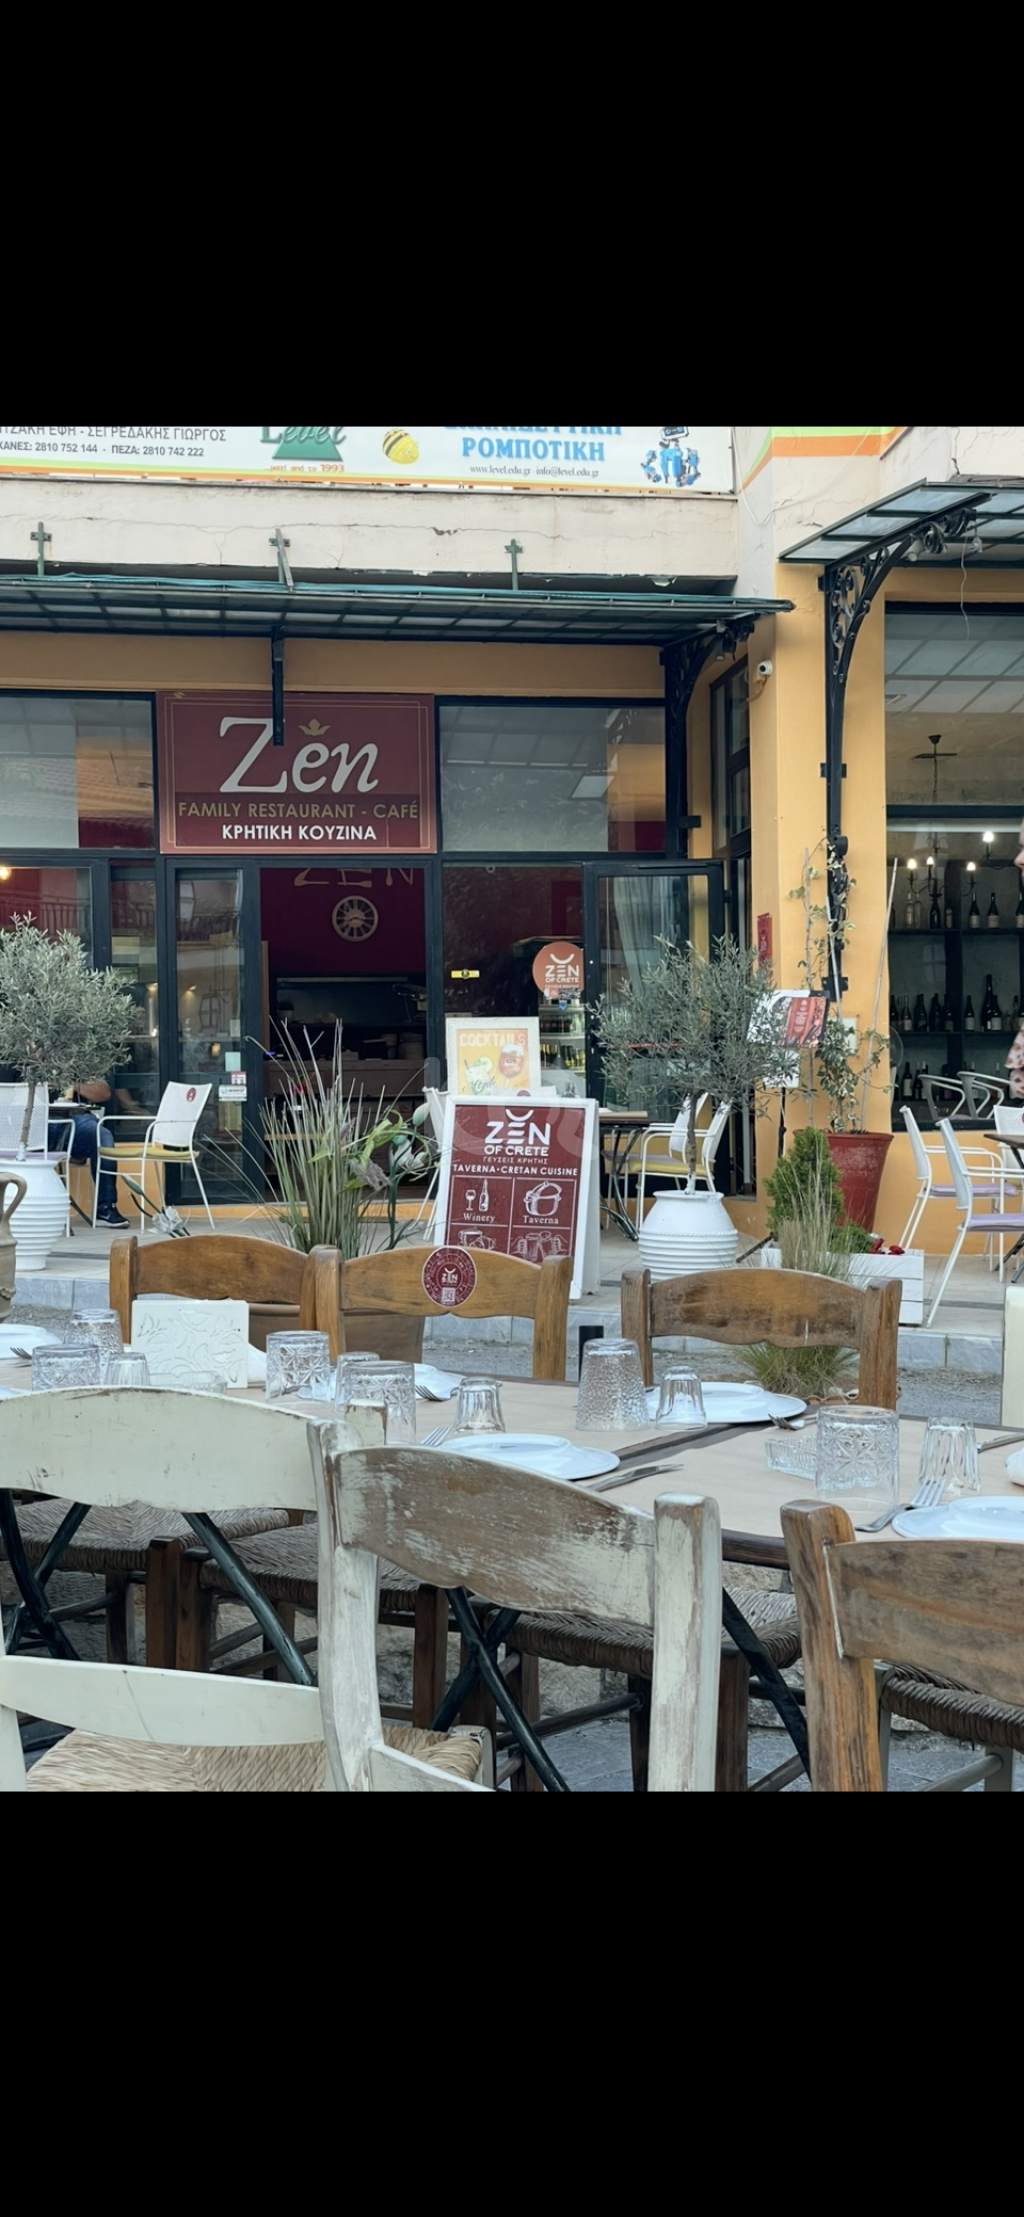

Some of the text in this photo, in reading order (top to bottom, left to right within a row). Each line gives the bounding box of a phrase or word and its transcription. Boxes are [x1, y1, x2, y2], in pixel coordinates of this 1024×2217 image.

[87, 427, 170, 440] ΣΕΓΡΕΔΑΚΗΣ
[174, 428, 227, 442] ΓΙΩΡΓΟΣ
[35, 442, 58, 452] 2810
[61, 443, 78, 453] 752
[81, 443, 98, 453] 144
[111, 444, 140, 455] ΠΕΖΑ:
[142, 445, 166, 456] 2810
[168, 446, 185, 456] 742
[187, 447, 205, 457] 222
[462, 437, 605, 461] ΡΟΜΠΟΤΙΚΗ
[320, 463, 345, 473] 1993
[470, 465, 531, 477] www.level.edu.gr
[535, 466, 600, 479] info@level.edu.gr
[219, 716, 379, 793] Zen
[178, 802, 242, 817] FAMILY
[248, 803, 355, 818] RESTAURANT
[373, 800, 418, 818] CAFÉ
[222, 824, 377, 840] ΚΡΗΤΙΚΗ ΚΟΥΖΙΝΑ
[545, 964, 580, 978] ZEN
[484, 1121, 551, 1146] ZEN
[484, 1144, 549, 1157] OF CRETE
[483, 1156, 549, 1165] ΓΕΥΣΕΙΣ ΚΡΗΤΗΣ
[540, 1167, 578, 1176] CUISINE
[463, 1212, 559, 1225] Winery Taverna
